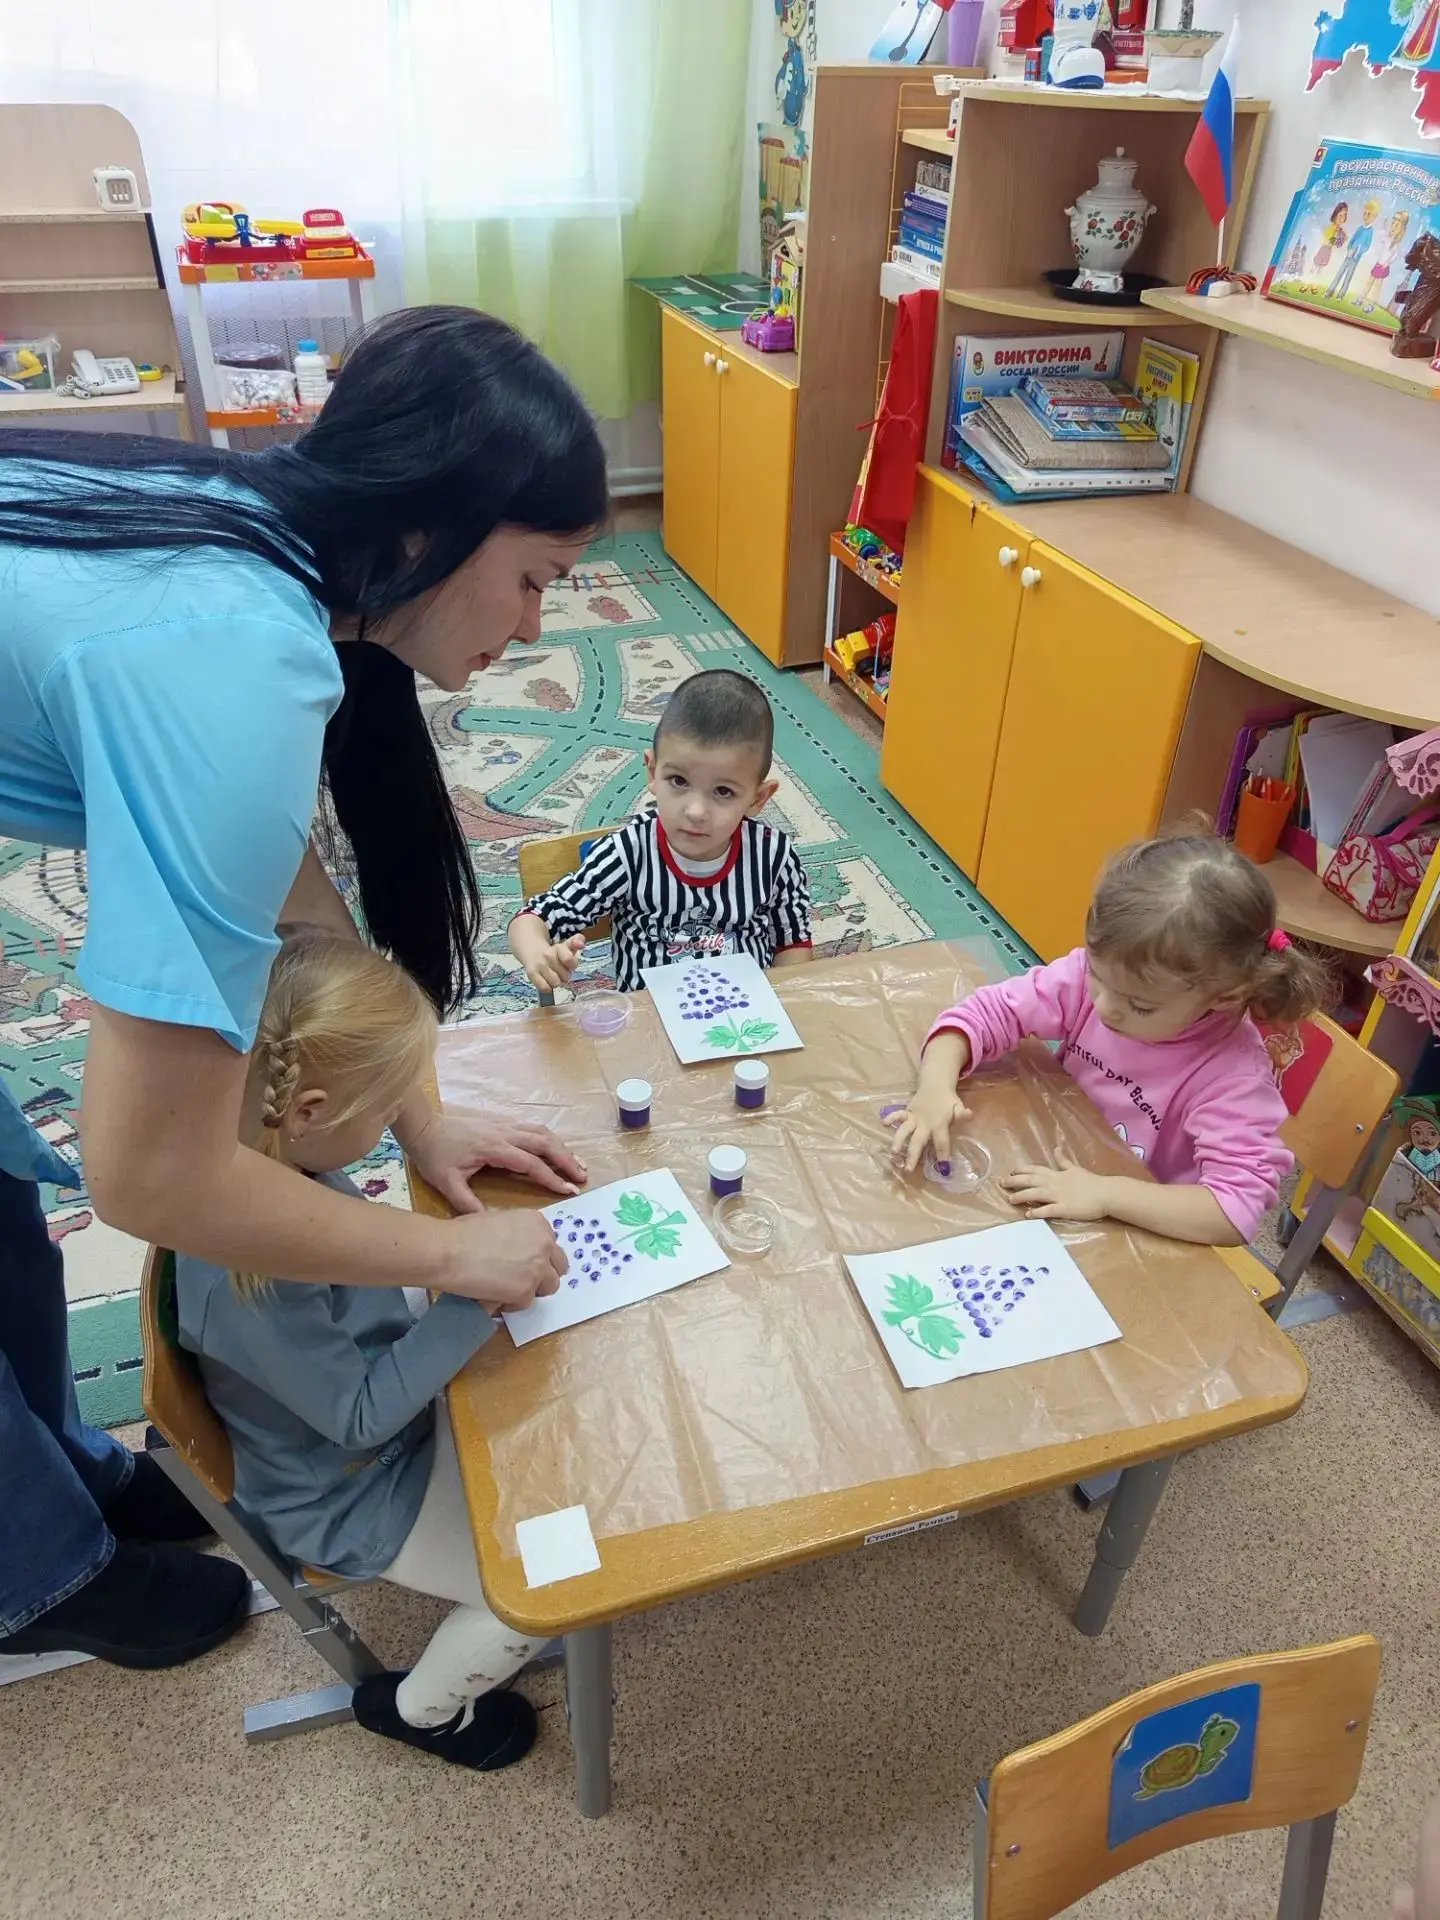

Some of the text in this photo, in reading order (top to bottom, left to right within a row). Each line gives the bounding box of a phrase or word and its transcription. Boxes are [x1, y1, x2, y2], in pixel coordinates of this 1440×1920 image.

[994, 346, 1092, 366] ВИКТОРИНА
[1000, 364, 1080, 377] СОСЕДИ РОССИИ
[1105, 1067, 1133, 1087] DAY
